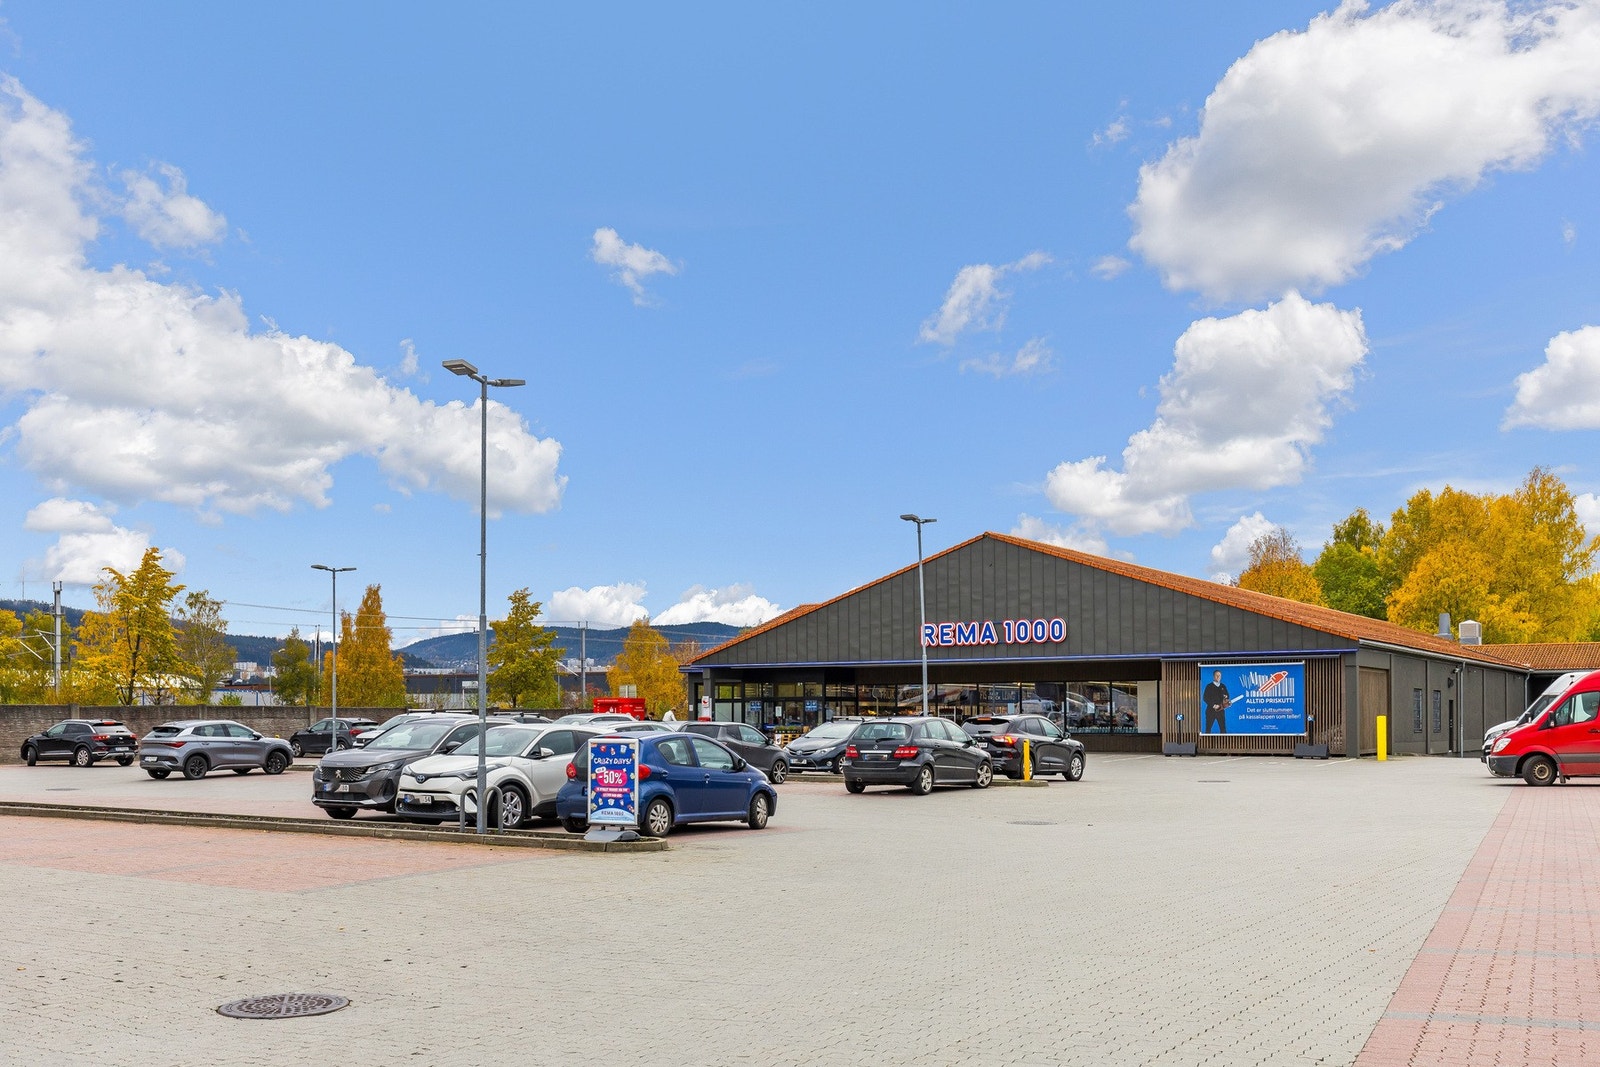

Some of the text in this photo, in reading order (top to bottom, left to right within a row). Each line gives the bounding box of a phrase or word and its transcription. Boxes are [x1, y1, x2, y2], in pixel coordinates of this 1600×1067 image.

[920, 616, 1067, 647] REMA 1000
[598, 770, 622, 784] -50%
